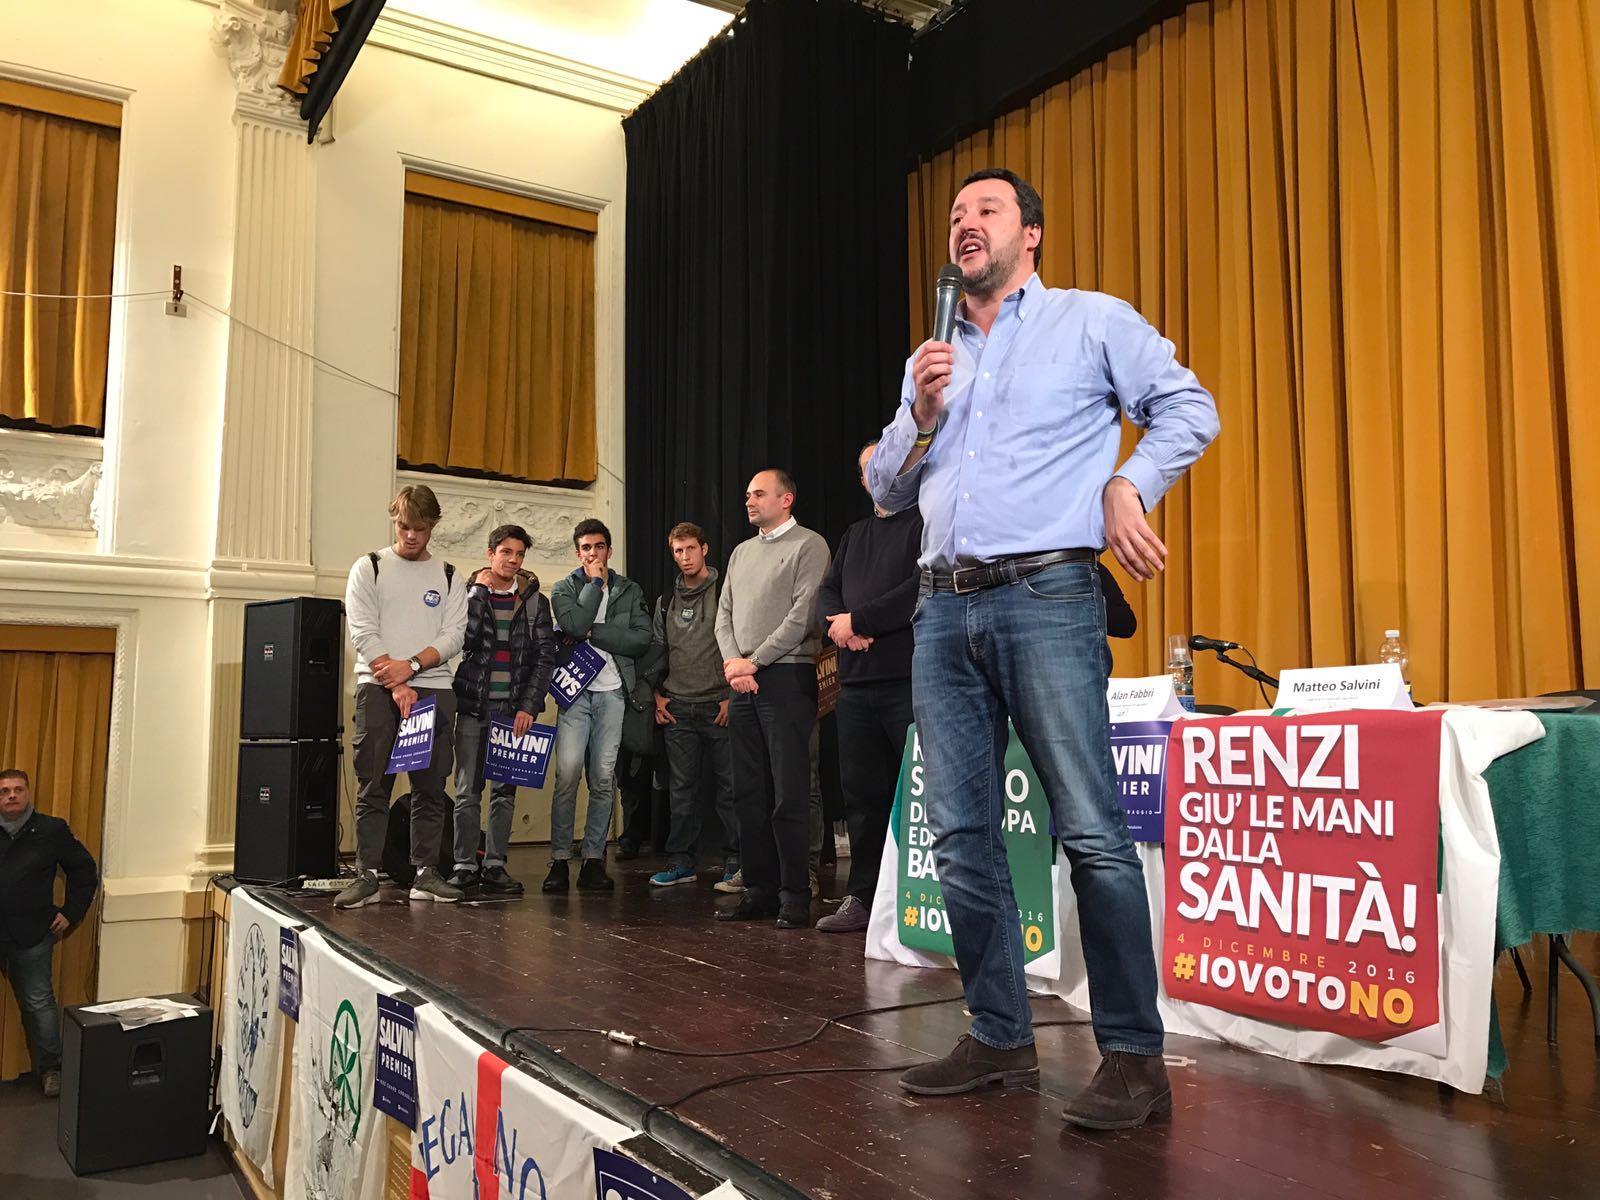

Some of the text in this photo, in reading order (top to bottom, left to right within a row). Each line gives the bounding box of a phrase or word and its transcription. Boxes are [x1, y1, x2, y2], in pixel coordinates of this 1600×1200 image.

[817, 656, 836, 680] LVINI
[1111, 688, 1154, 700] Alan Fabbri
[1293, 679, 1380, 692] Matteo Salvini
[398, 710, 433, 737] SALVINI
[398, 733, 428, 748] PREMIER
[490, 727, 549, 754] SALVINI
[493, 748, 537, 764] PREMIER
[1111, 745, 1162, 775] VINI
[1182, 724, 1359, 789] RENZI
[1250, 794, 1284, 828] LE
[1293, 800, 1393, 836] MANI
[1179, 826, 1281, 865] DALLA
[905, 890, 911, 899] 4
[1177, 862, 1417, 951] SANITÀ!
[1177, 933, 1415, 984] 4 DICEMBRE 2016
[1172, 952, 1414, 1024] #IOVOTONO
[380, 1016, 413, 1062] SALVINI
[381, 1053, 411, 1080] PREMIER
[419, 1092, 473, 1181] EGA
